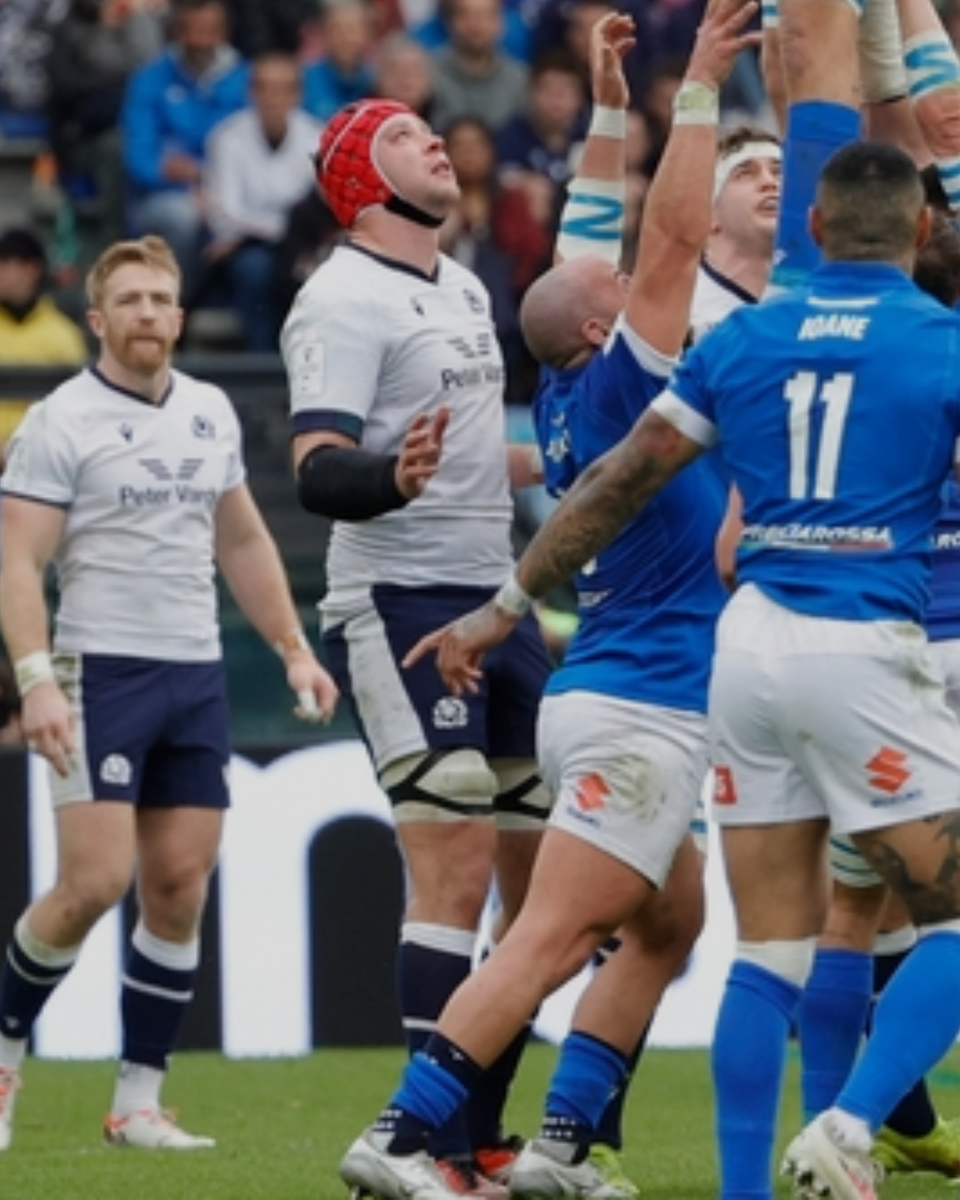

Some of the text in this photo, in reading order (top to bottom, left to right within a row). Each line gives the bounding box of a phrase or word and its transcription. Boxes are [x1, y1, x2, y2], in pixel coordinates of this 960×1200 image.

[797, 314, 870, 341] IOANE
[783, 370, 854, 500] 11
[118, 484, 171, 507] Peter
